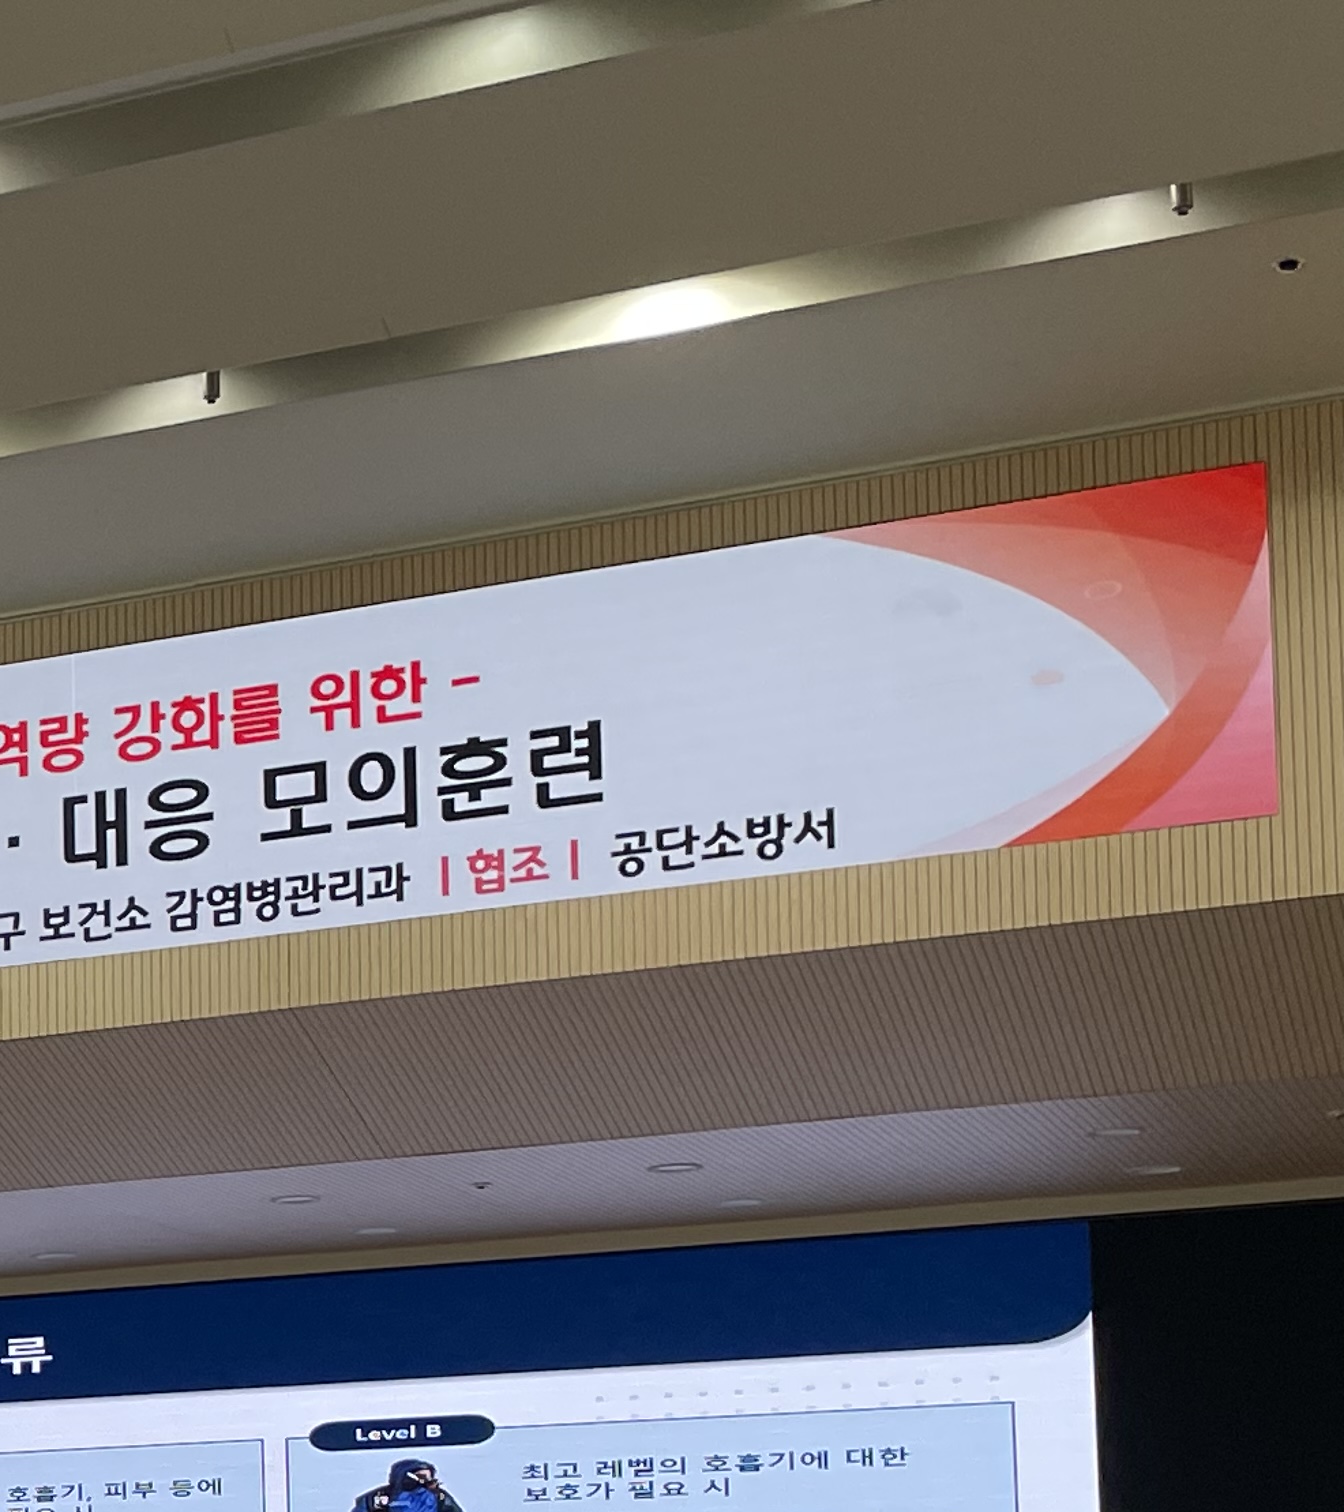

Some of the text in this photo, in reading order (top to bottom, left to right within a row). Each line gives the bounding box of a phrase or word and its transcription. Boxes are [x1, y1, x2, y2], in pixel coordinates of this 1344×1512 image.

[113, 683, 282, 763] 강화를
[310, 660, 427, 732] 위한
[62, 777, 214, 870] 대응
[259, 718, 605, 842] 모의훈련
[38, 896, 152, 945] 보건소
[166, 860, 411, 932] 감염병관리과
[467, 844, 552, 895] 협조
[611, 807, 837, 879] 공단소방서
[355, 1424, 442, 1442] Level B
[521, 1445, 910, 1481] 최고 레벨의 호흡기에 대한
[5, 1482, 93, 1503] 호흡기,
[103, 1480, 158, 1501] 피부
[169, 1477, 224, 1498] 등에
[522, 1477, 730, 1502] 보호가 필요 시
